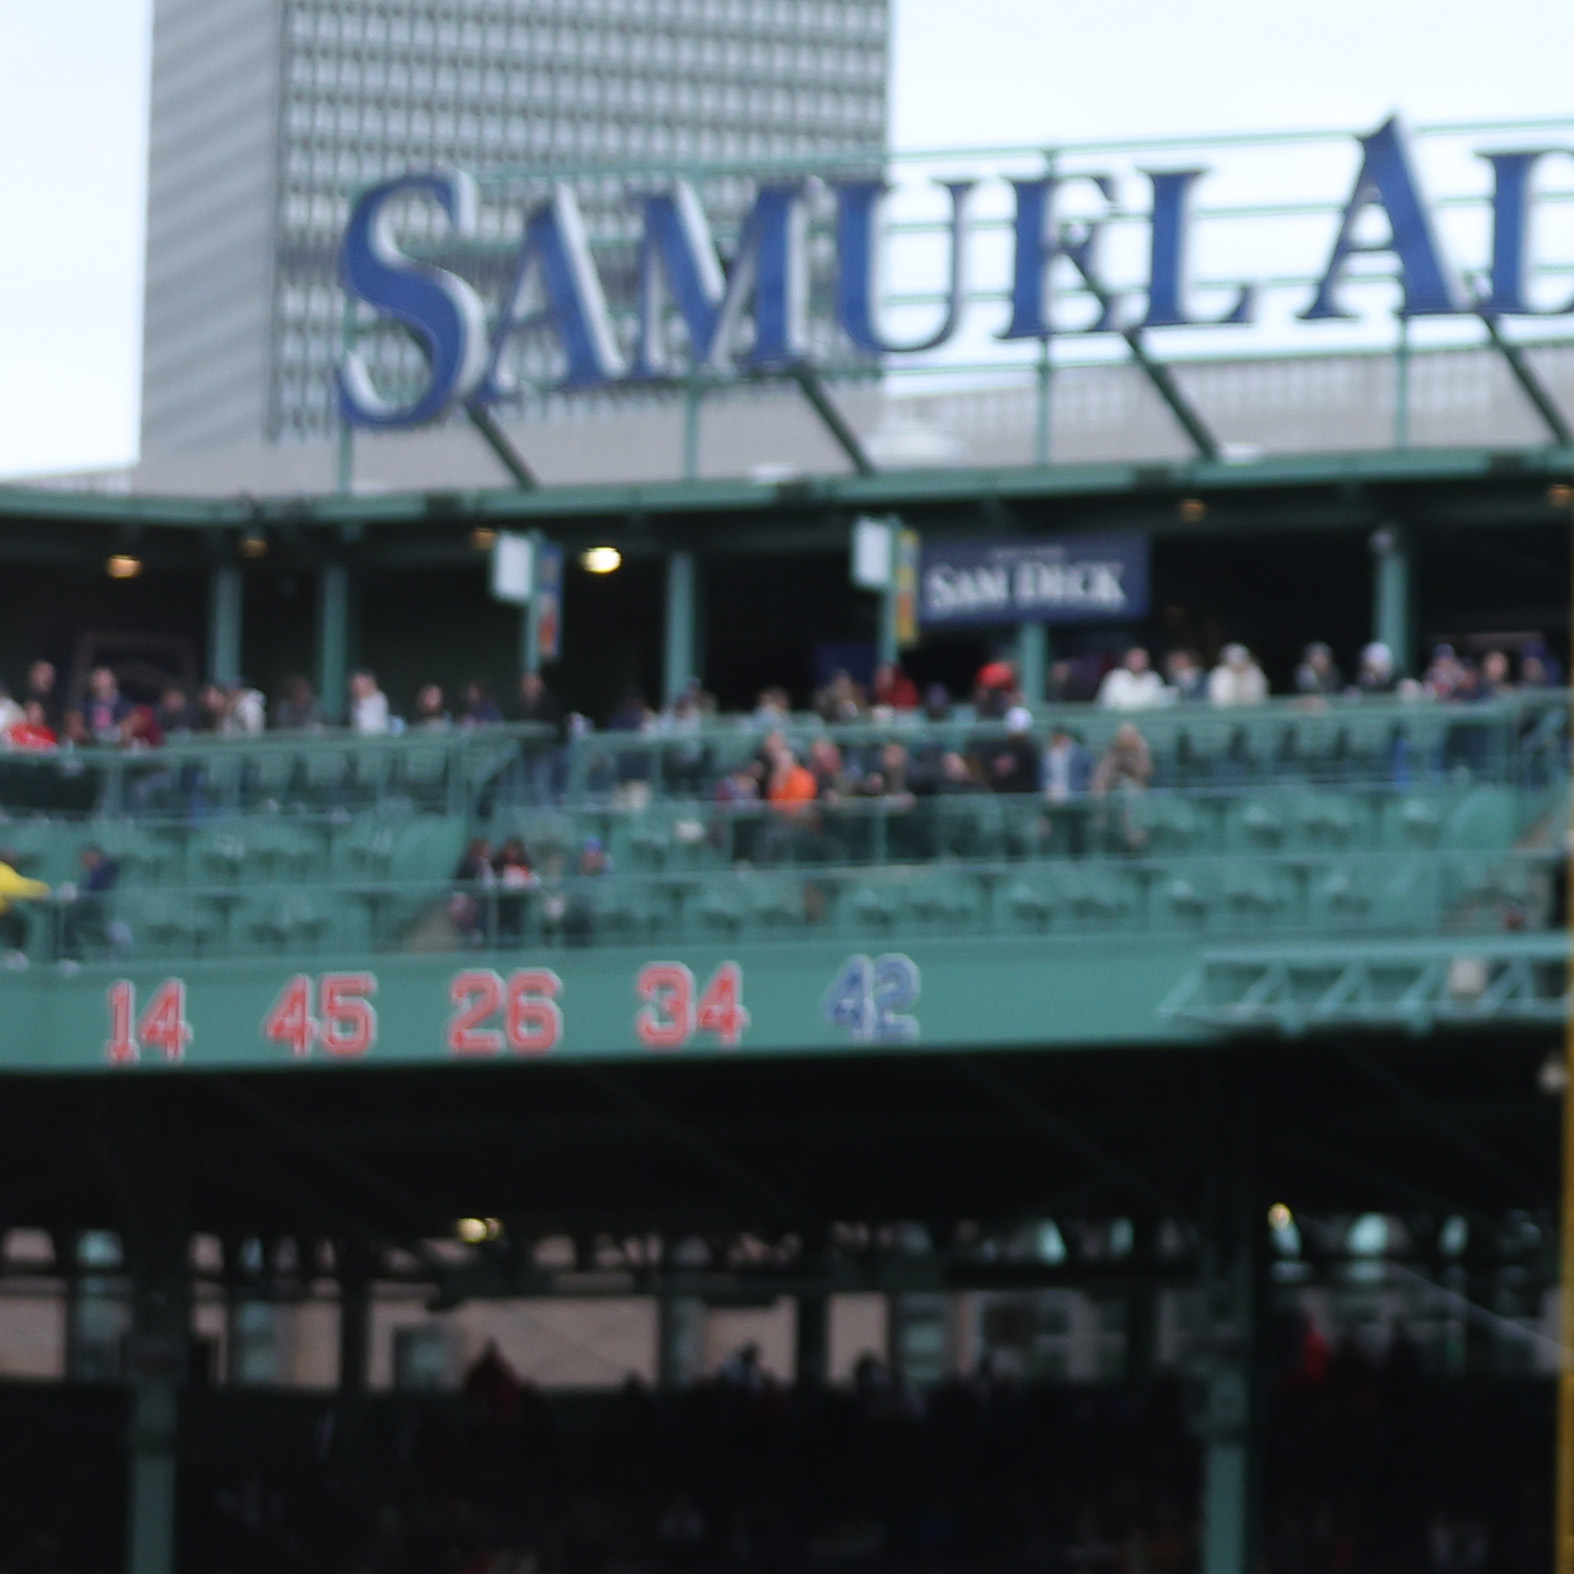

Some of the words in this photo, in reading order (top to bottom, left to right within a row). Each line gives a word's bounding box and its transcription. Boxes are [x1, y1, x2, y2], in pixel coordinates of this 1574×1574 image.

[337, 167, 1255, 428] SAMUEL
[104, 977, 194, 1064] 14
[262, 970, 379, 1059] 45
[447, 966, 563, 1058] 26
[636, 959, 750, 1050] 34
[828, 951, 923, 1043] 42
